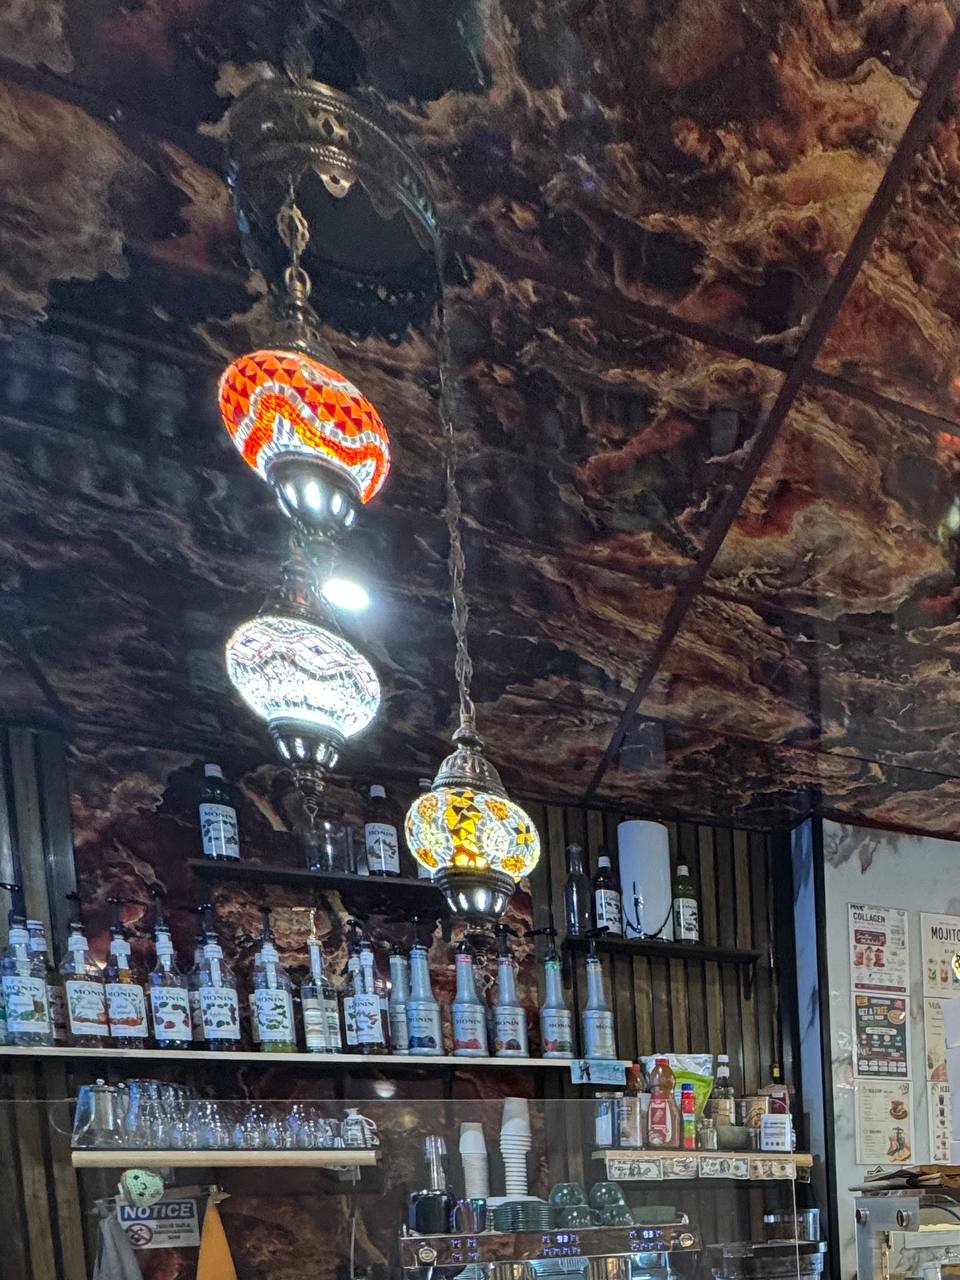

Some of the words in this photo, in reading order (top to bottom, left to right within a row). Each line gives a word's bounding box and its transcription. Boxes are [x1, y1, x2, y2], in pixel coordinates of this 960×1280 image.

[204, 811, 234, 820] MONIN
[368, 830, 395, 838] MONIN
[852, 911, 886, 924] COLLAGEN
[5, 984, 40, 993] MONIN
[107, 990, 139, 999] MONIN
[154, 994, 185, 1002] MONIN
[873, 1006, 889, 1015] FREE
[455, 1018, 482, 1026] MONIN
[124, 1203, 193, 1219] NOTICE
[556, 1234, 568, 1243] 93
